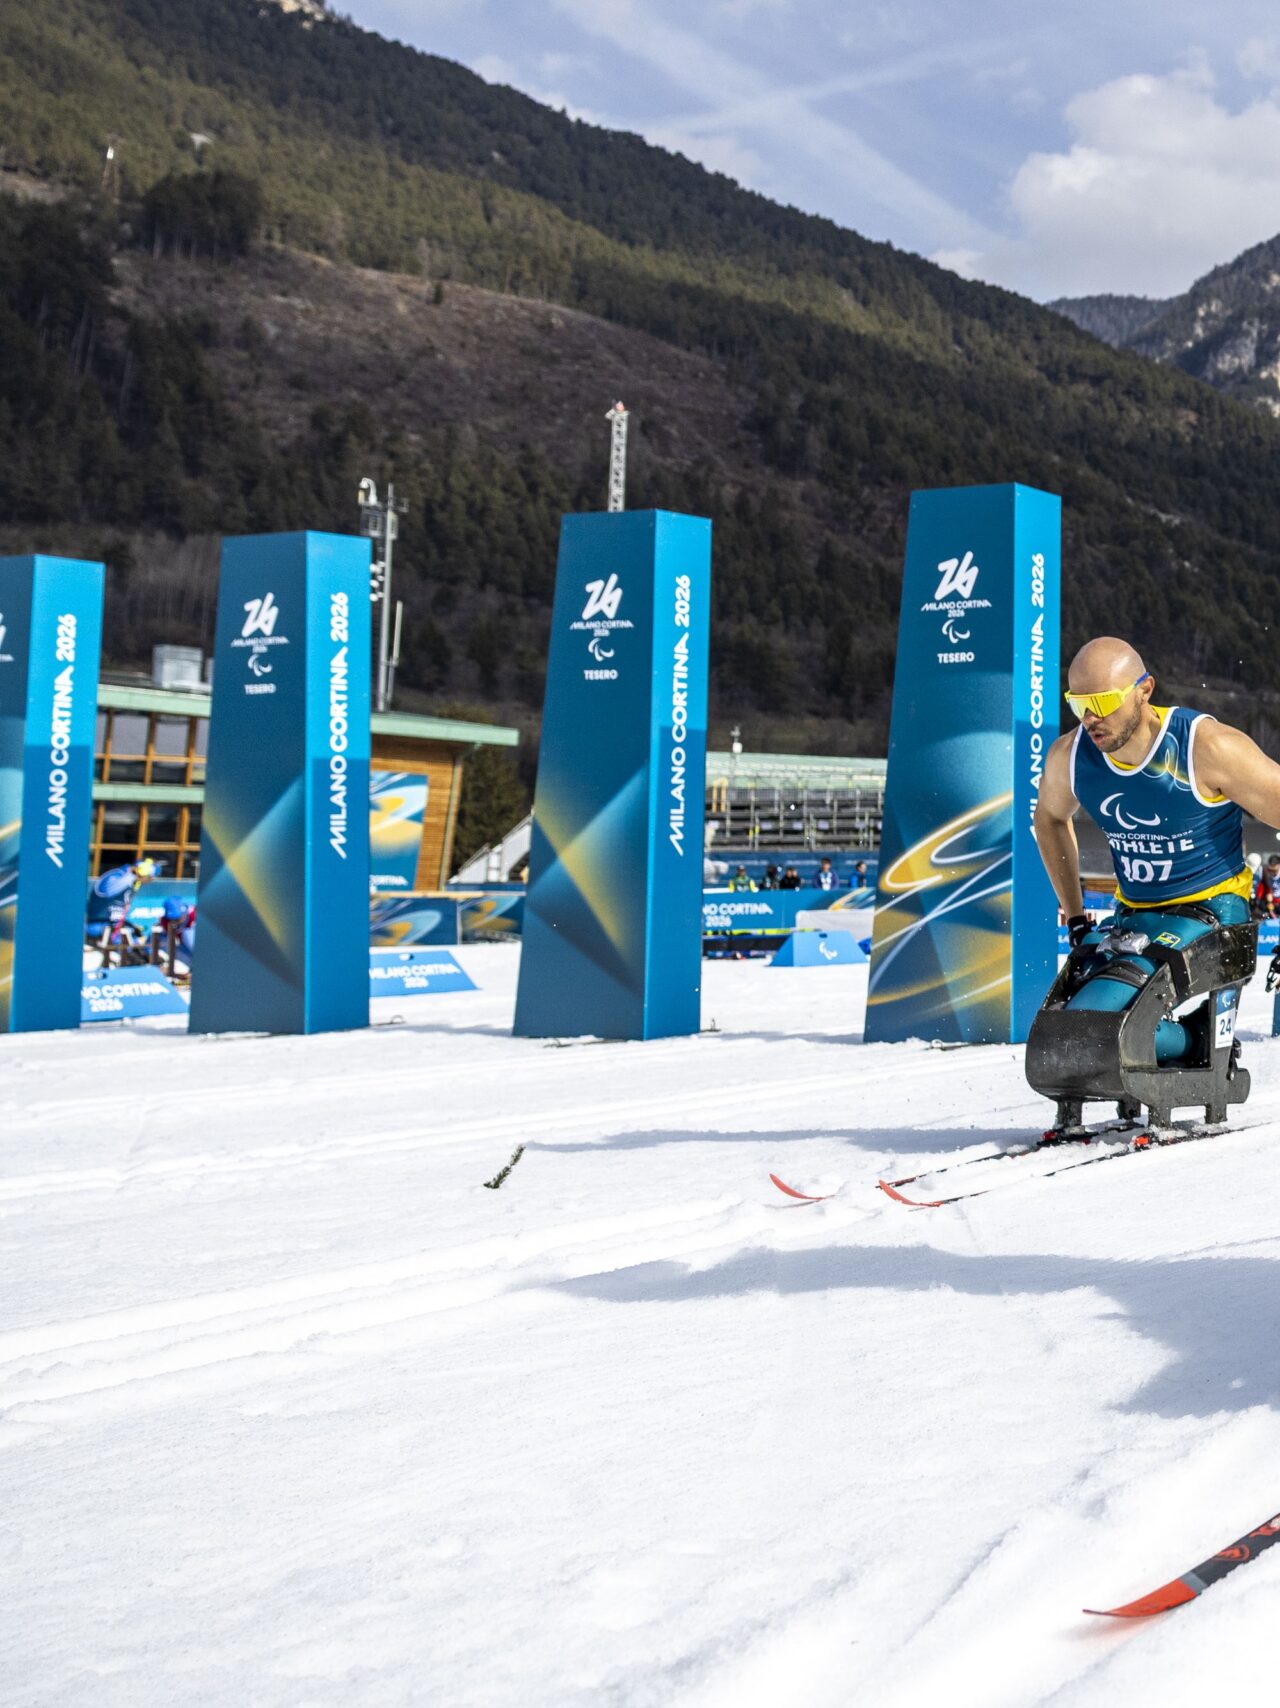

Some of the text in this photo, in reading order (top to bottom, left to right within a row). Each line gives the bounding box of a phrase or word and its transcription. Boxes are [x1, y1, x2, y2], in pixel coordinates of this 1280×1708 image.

[1031, 552, 1045, 609] 2026
[920, 599, 993, 612] MILANO CORTINA
[947, 609, 965, 617] 2026
[569, 619, 635, 630] MILANO CORTINA
[937, 652, 975, 664] TESERO
[583, 669, 618, 680] TESERO
[1030, 613, 1044, 729] CORTINA
[669, 574, 691, 856] MILANO CORTINA 2026
[329, 592, 349, 860] MILANO CORTINA 2026
[45, 613, 77, 869] MILANO CORTINA 2026
[1127, 832, 1170, 841] CORTINA
[1120, 855, 1173, 883] 107
[719, 902, 773, 916] CORTINA
[101, 982, 170, 998] CORTINA
[1220, 1017, 1232, 1036] 24
